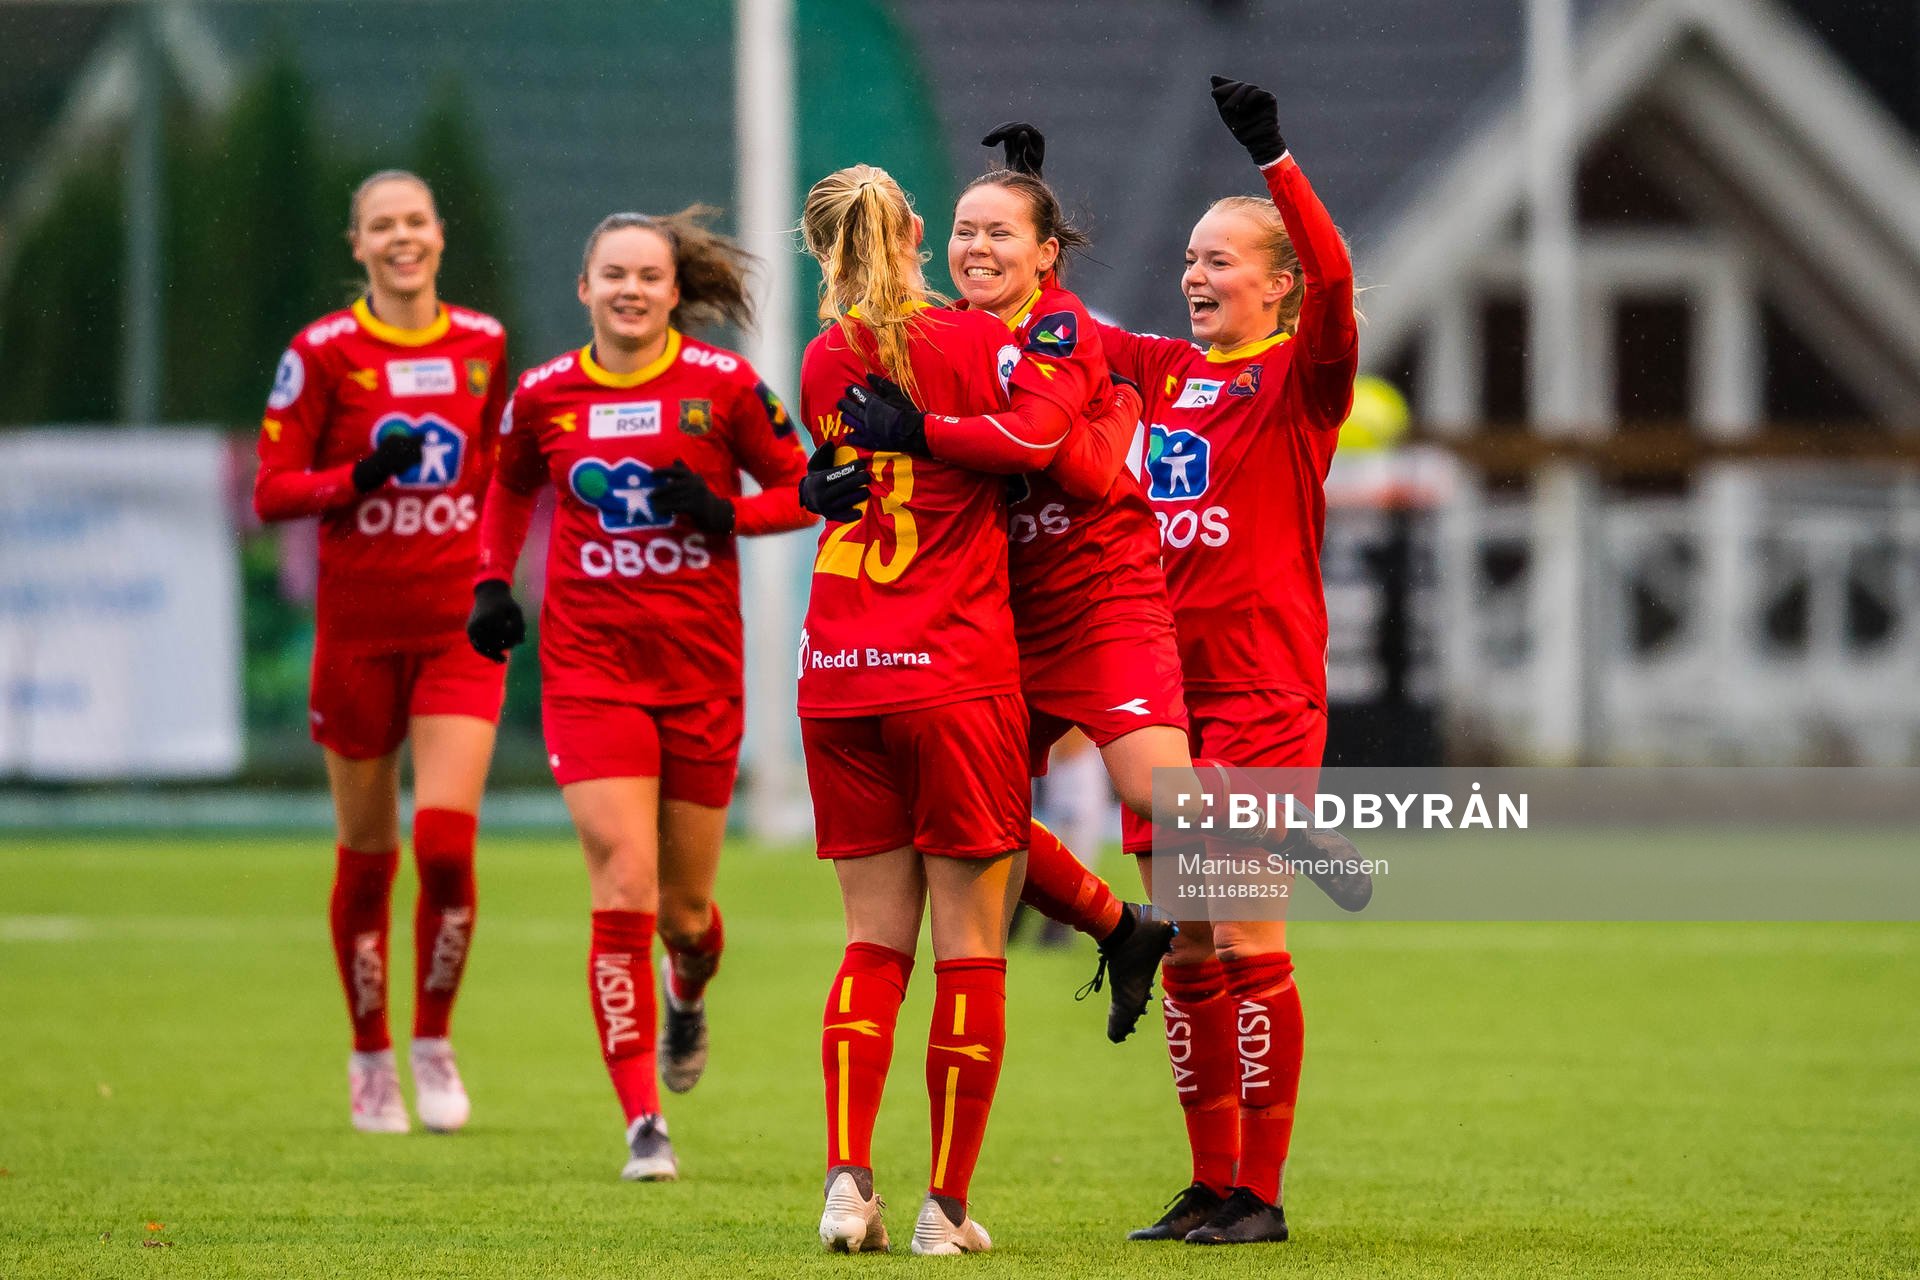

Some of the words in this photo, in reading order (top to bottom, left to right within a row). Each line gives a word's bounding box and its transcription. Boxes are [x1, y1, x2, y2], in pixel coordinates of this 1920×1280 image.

[616, 417, 656, 432] RSM
[357, 494, 476, 535] OBOS
[814, 446, 919, 583] 23
[580, 533, 711, 578] OBOS
[812, 649, 858, 669] Redd
[865, 648, 931, 668] Barna
